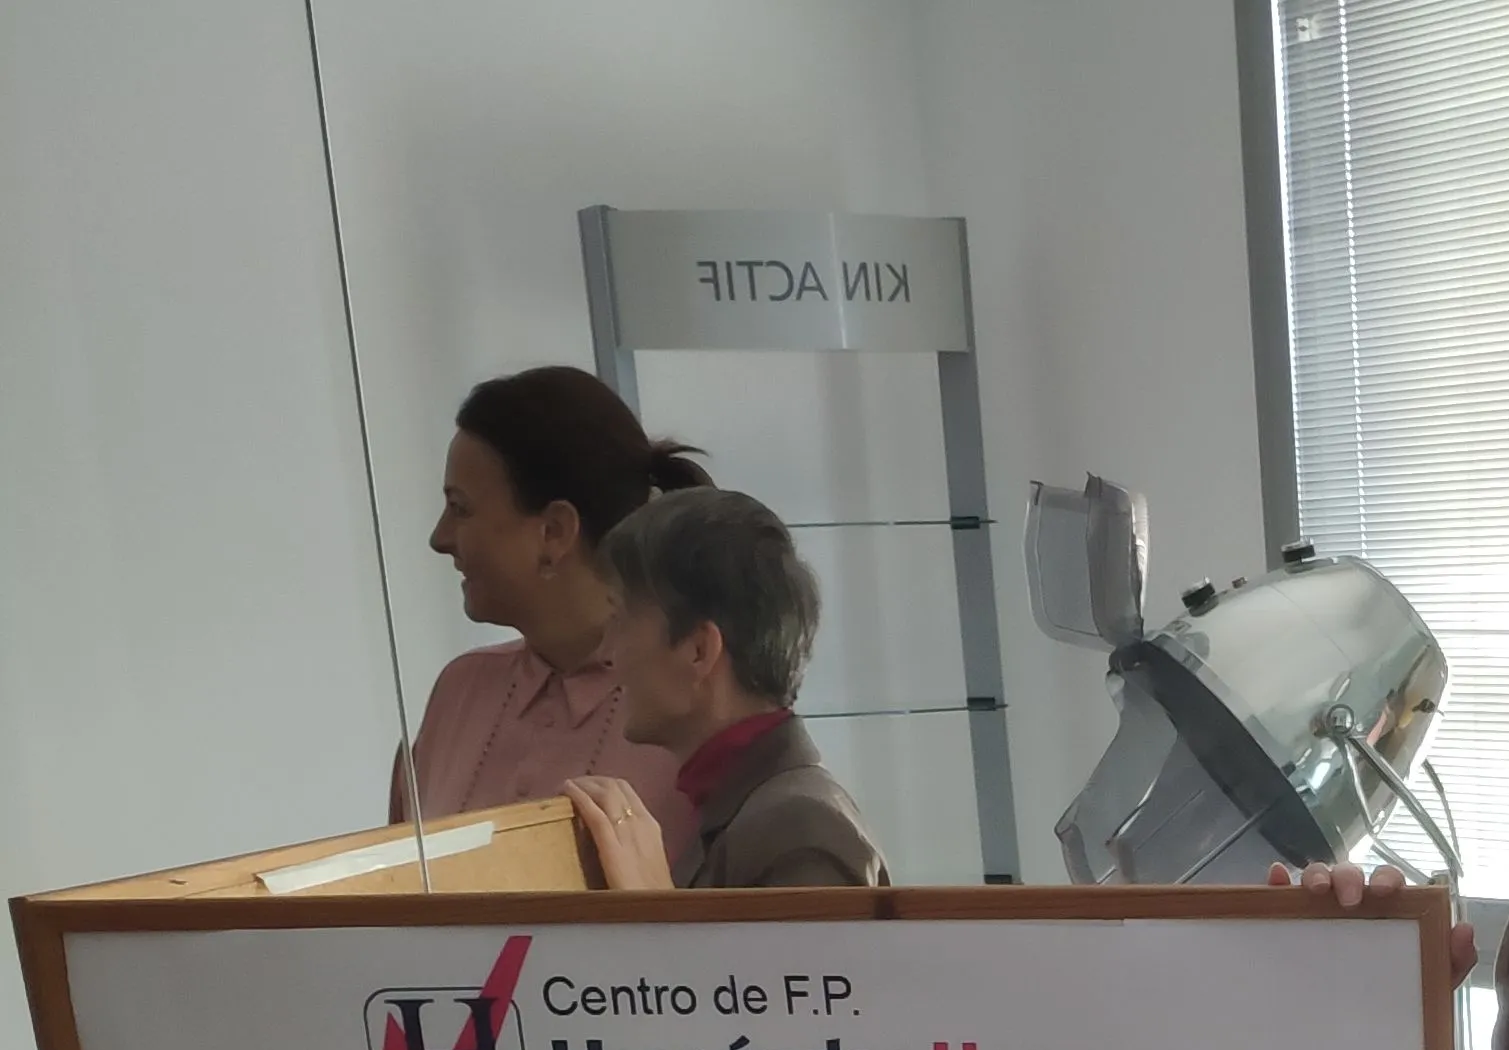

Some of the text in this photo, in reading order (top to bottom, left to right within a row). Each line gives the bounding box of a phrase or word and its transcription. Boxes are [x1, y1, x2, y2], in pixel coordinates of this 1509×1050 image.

[543, 974, 860, 1017] Centro de F.P.
